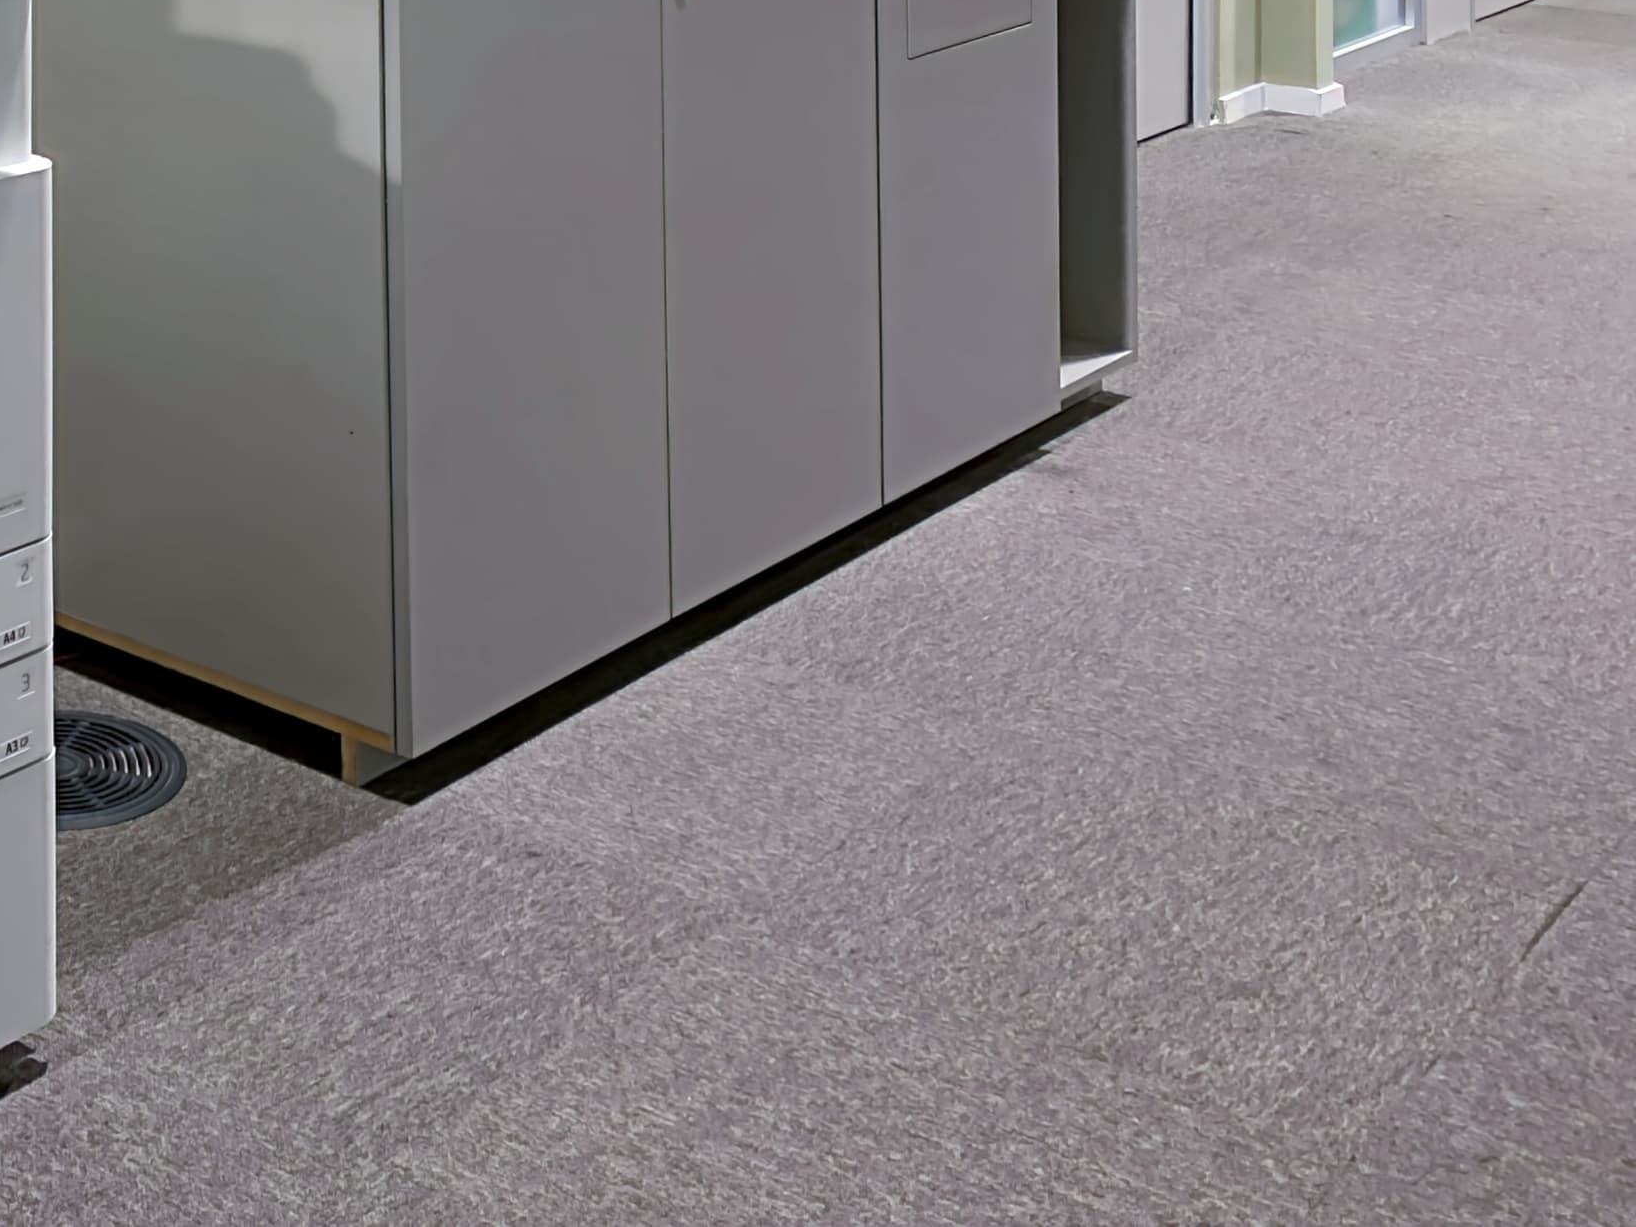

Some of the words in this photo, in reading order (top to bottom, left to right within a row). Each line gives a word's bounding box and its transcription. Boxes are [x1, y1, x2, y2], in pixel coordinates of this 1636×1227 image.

[20, 563, 30, 583] 2
[3, 630, 16, 645] A4
[21, 673, 31, 693] 3
[5, 739, 19, 756] A3
